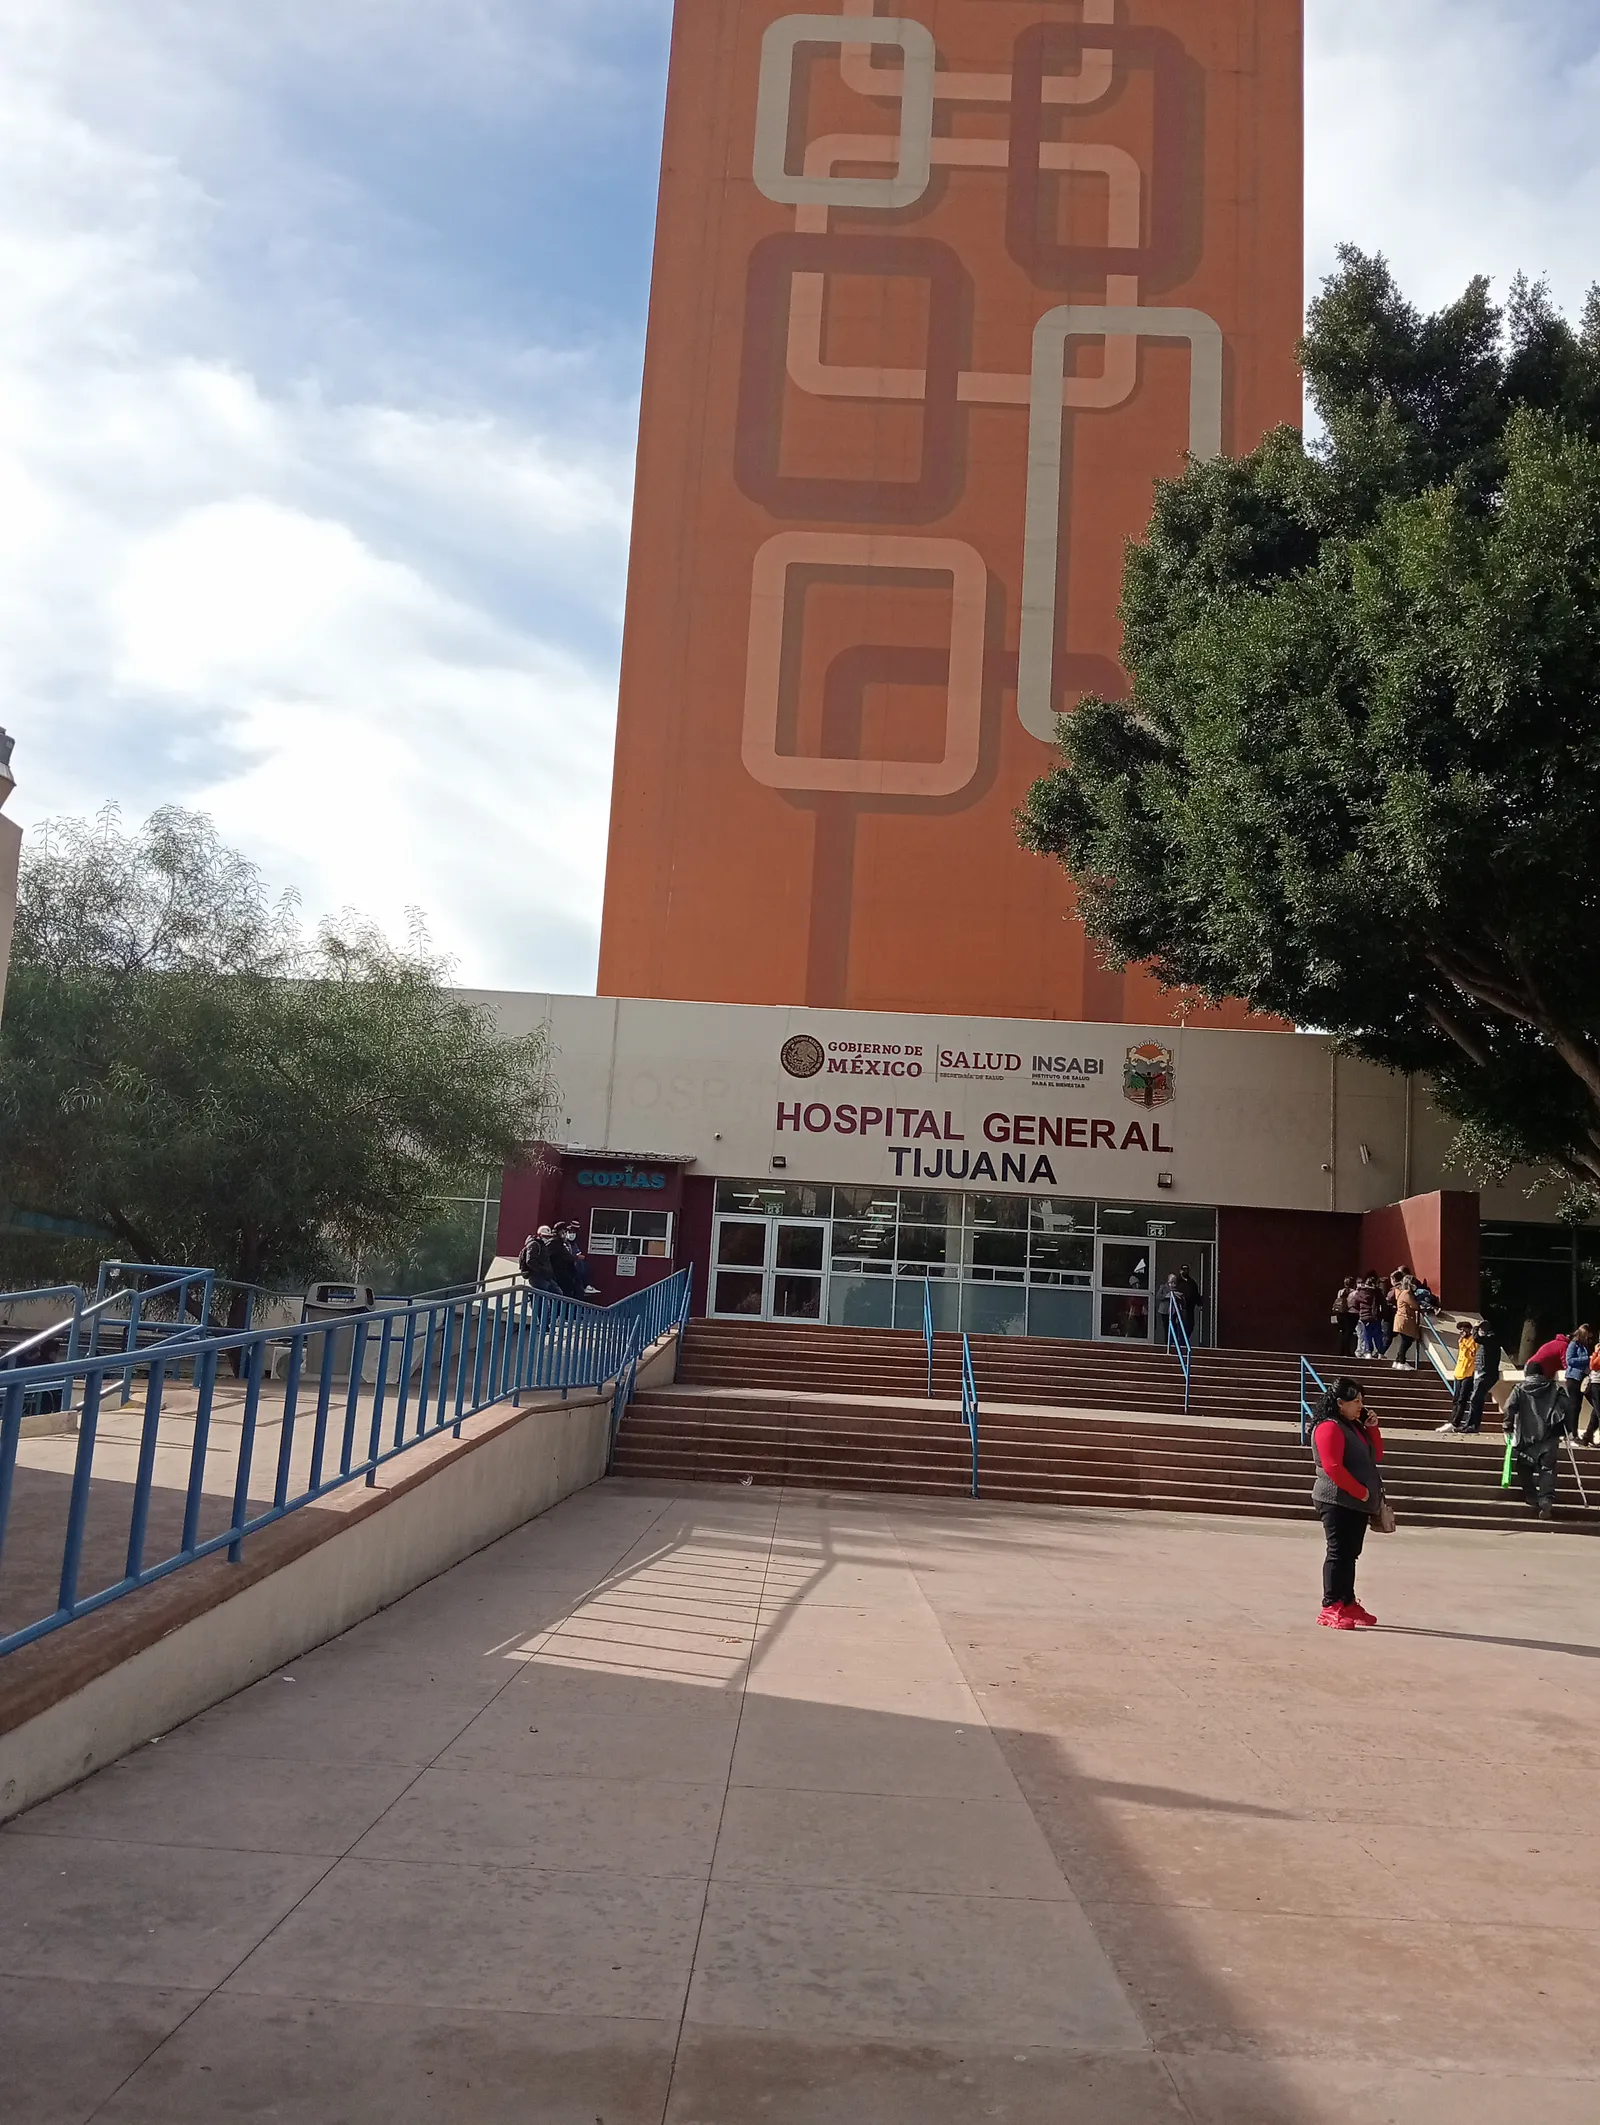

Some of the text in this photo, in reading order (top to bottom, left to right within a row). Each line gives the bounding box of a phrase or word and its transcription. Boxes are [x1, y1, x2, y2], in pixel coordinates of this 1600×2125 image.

[828, 1041, 923, 1056] GOBIERNO DE
[826, 1054, 922, 1078] MÉXICO
[940, 1050, 1022, 1071] SALUD
[1032, 1055, 1104, 1075] INSABI
[776, 1101, 1174, 1153] HOSPITAL GENERAL
[887, 1146, 1058, 1185] TIJUANA
[577, 1168, 666, 1190] COPIAS
